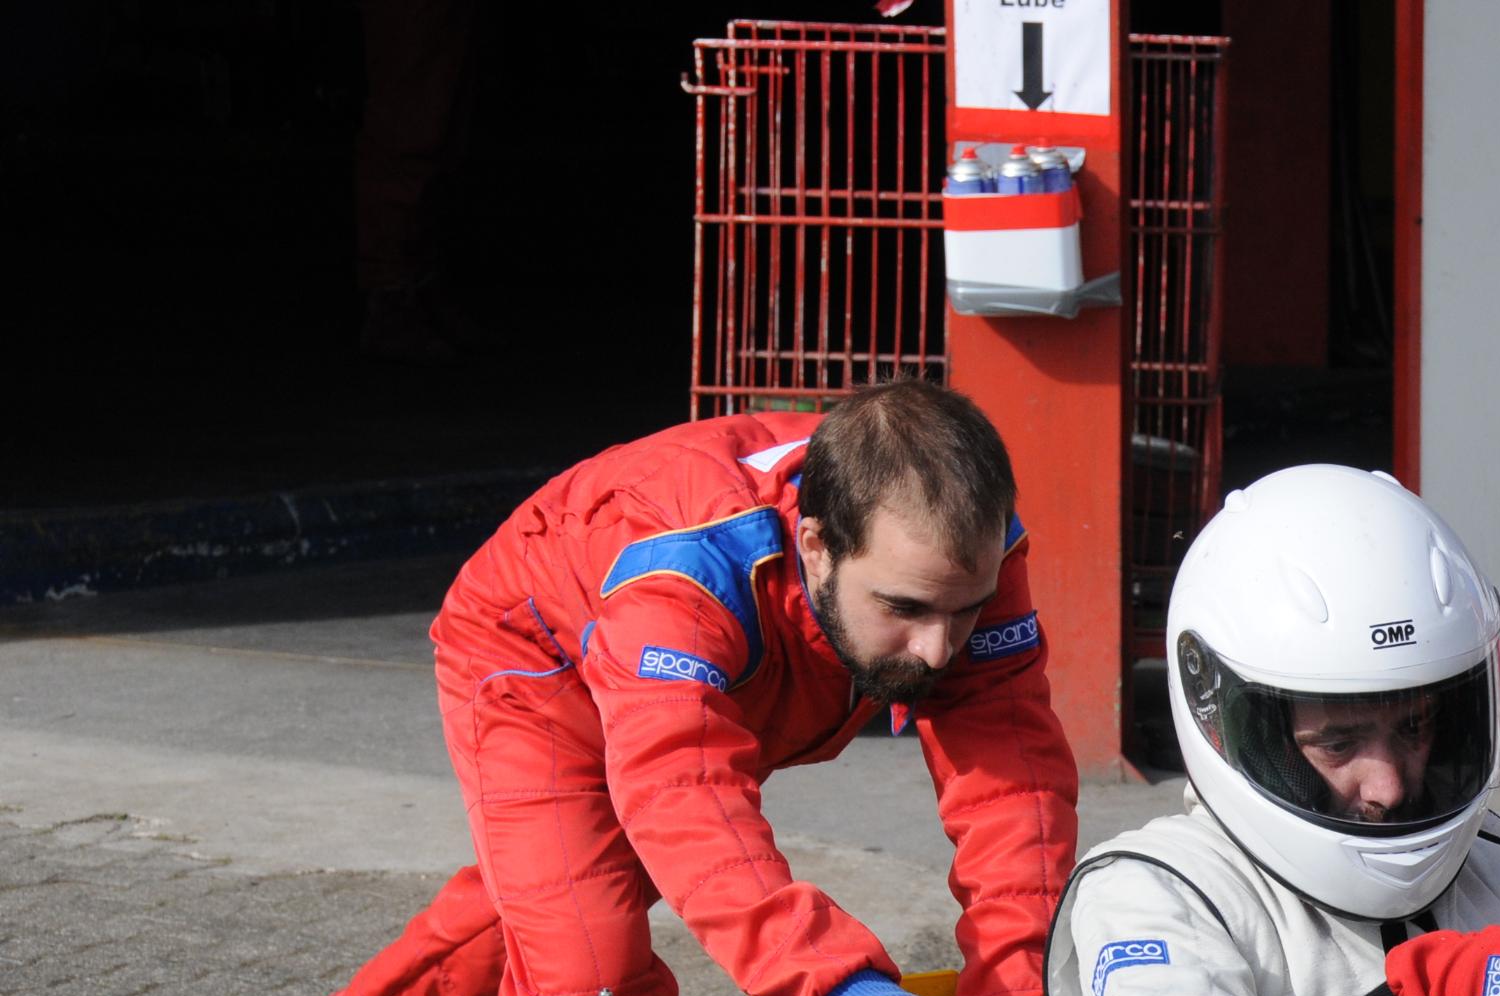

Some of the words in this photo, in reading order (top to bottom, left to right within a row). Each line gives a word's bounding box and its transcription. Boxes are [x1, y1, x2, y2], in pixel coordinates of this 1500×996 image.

[970, 616, 1037, 655] sparc
[1371, 625, 1415, 645] OMP
[642, 651, 727, 693] sparco
